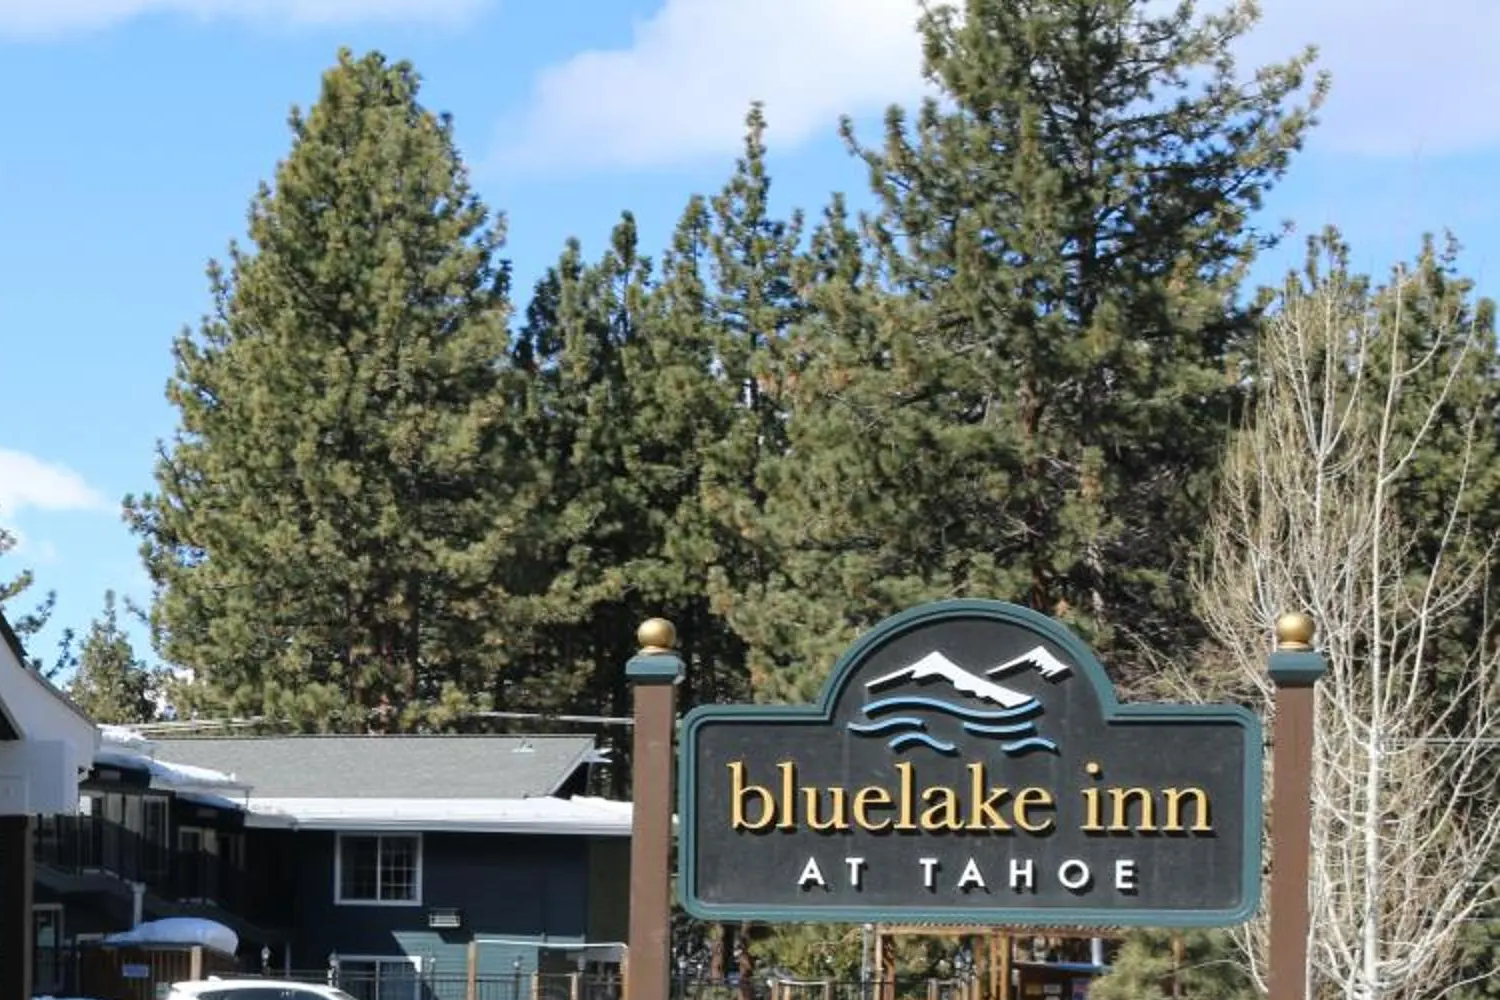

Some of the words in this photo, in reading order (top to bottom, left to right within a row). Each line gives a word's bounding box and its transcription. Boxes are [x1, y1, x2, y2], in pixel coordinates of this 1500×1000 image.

[726, 761, 1053, 831] bluelake
[1080, 761, 1213, 832] inn
[798, 856, 865, 886] AT
[919, 857, 1135, 889] TAHOE
